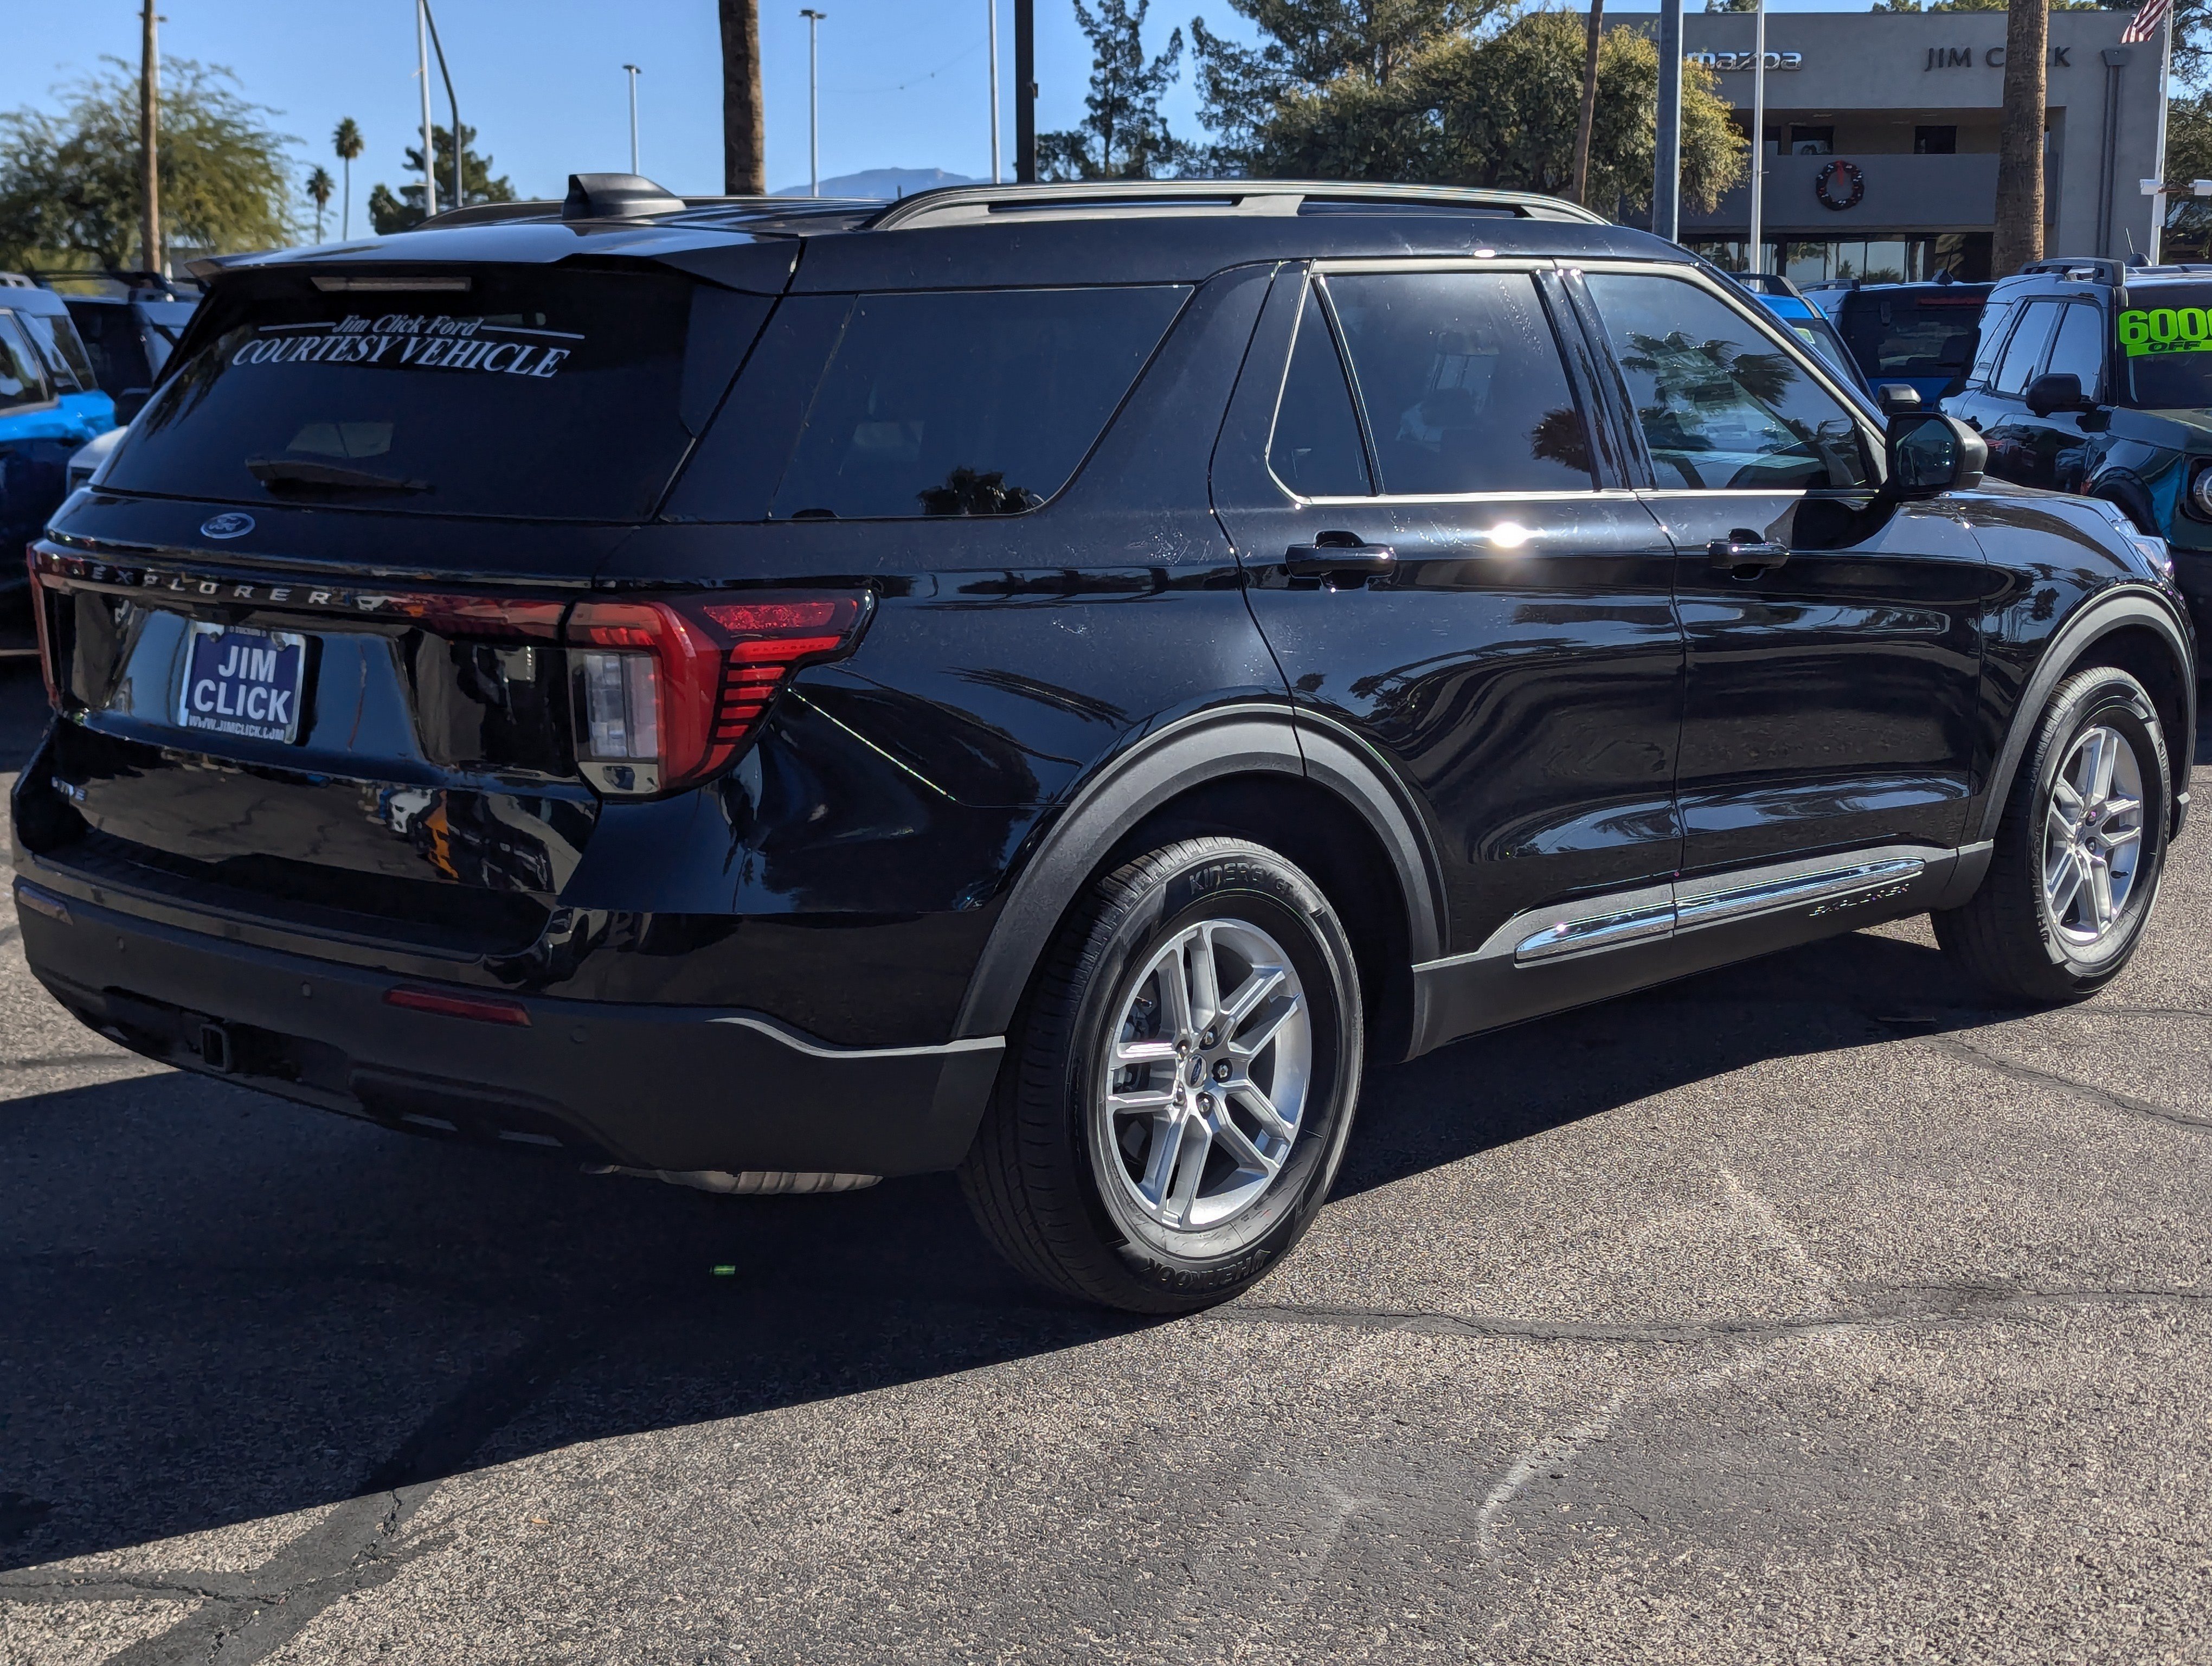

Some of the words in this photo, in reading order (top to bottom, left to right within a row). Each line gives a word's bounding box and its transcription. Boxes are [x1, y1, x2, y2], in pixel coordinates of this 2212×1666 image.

[1924, 47, 1972, 72] JIM
[332, 315, 371, 333] Jim
[372, 313, 428, 334] Click
[423, 315, 484, 336] Ford
[2119, 307, 2212, 345] 600
[232, 335, 397, 366] COURTESY
[398, 337, 571, 378] VEHICLE
[2148, 341, 2201, 353] OFF
[218, 645, 277, 683] JIM
[194, 678, 292, 725] CLICK
